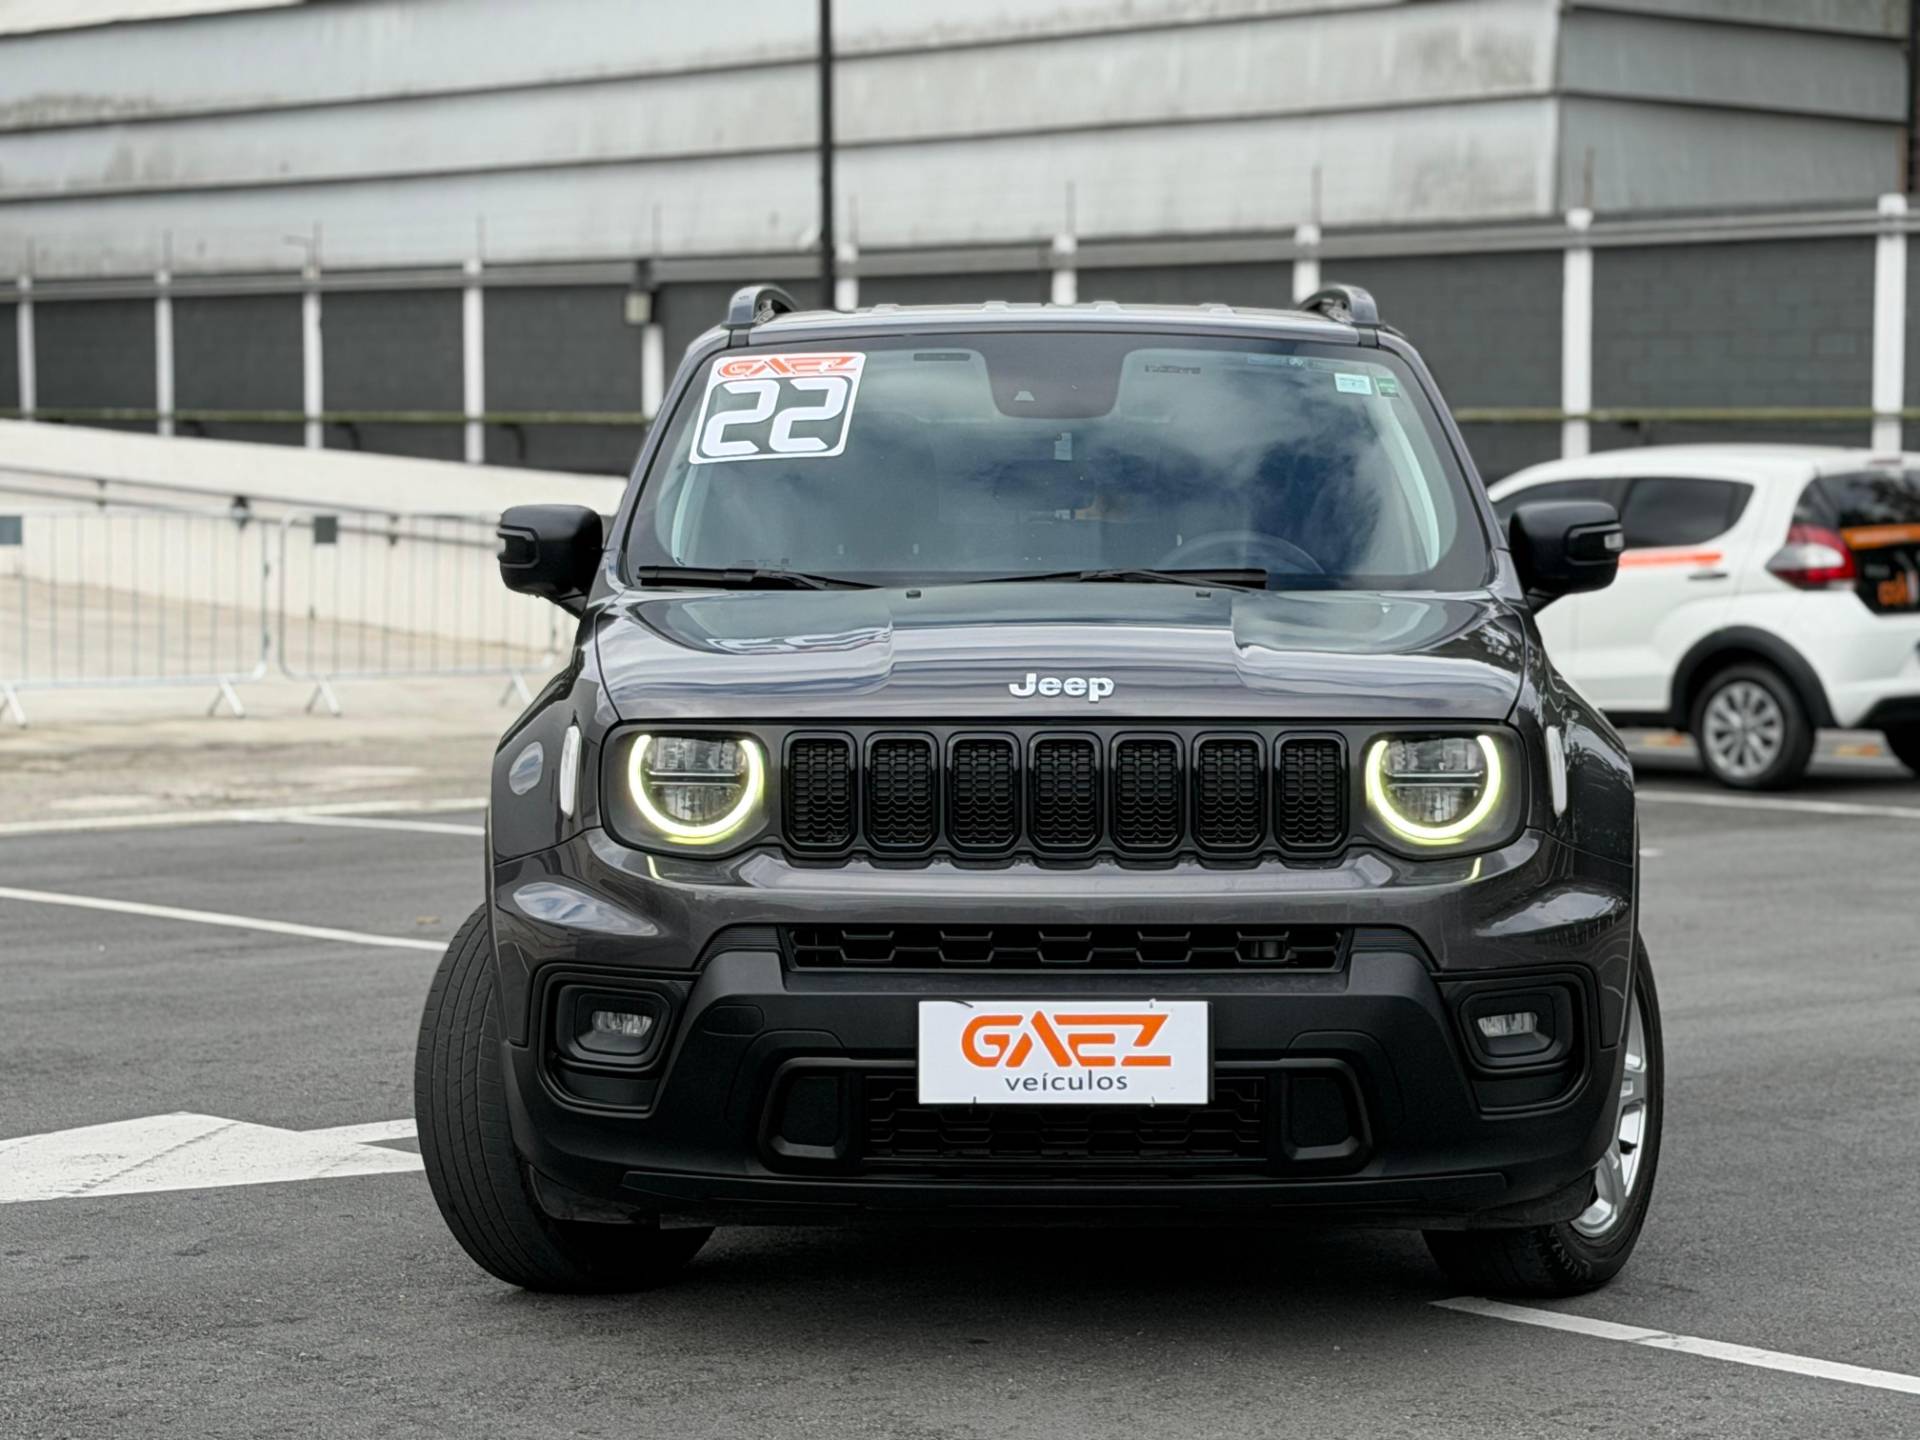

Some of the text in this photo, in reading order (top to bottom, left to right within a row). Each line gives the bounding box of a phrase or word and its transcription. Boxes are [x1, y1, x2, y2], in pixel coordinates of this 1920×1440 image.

[701, 376, 849, 457] 22
[1008, 672, 1115, 702] Jeep
[961, 1010, 1172, 1068] GAEZ
[1005, 1070, 1128, 1091] veículos
